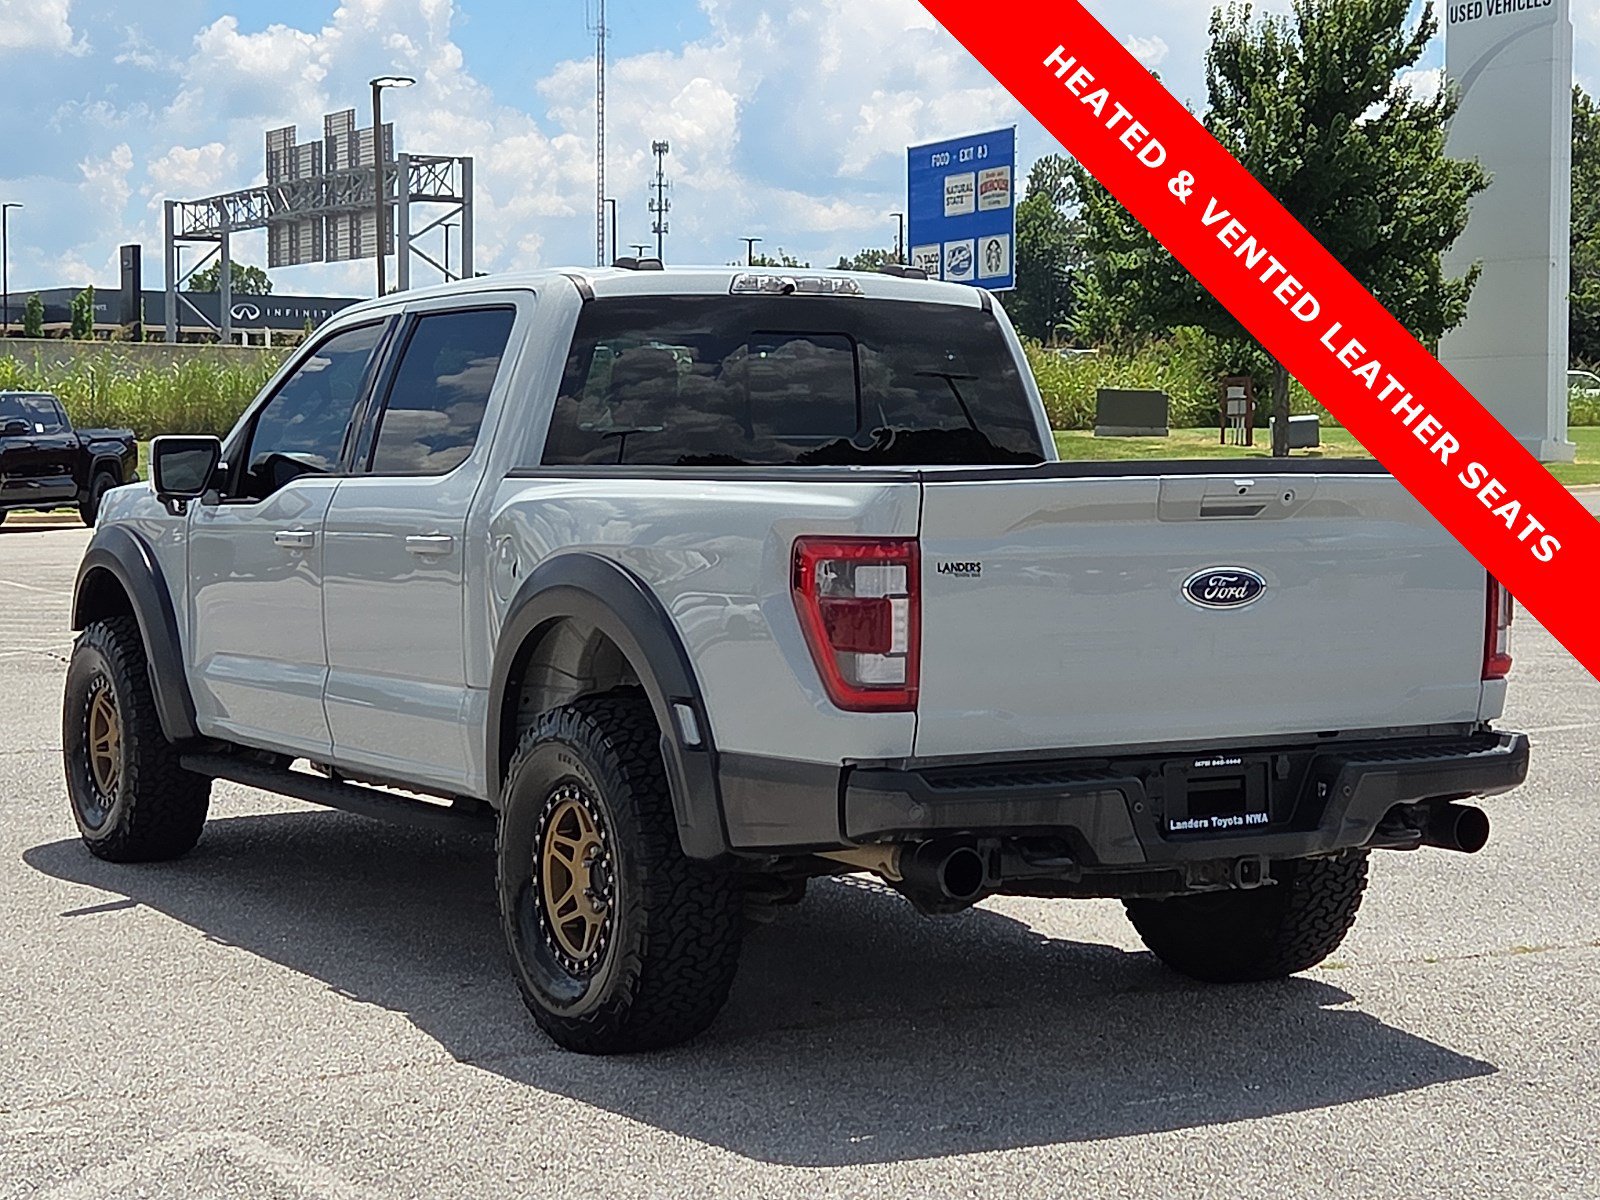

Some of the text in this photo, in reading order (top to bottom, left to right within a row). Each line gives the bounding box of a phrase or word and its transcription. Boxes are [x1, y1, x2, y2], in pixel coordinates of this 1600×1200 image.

[1450, 1, 1482, 24] USED
[931, 152, 950, 167] FOOD
[959, 147, 974, 162] EXIT
[977, 144, 988, 159] 83
[946, 182, 973, 196] NATURAL
[946, 195, 964, 206] STATE
[924, 252, 939, 264] TACO
[937, 562, 981, 574] LANDERS
[1204, 575, 1249, 600] Ford
[1170, 813, 1268, 830] Landers Toyota NWA
